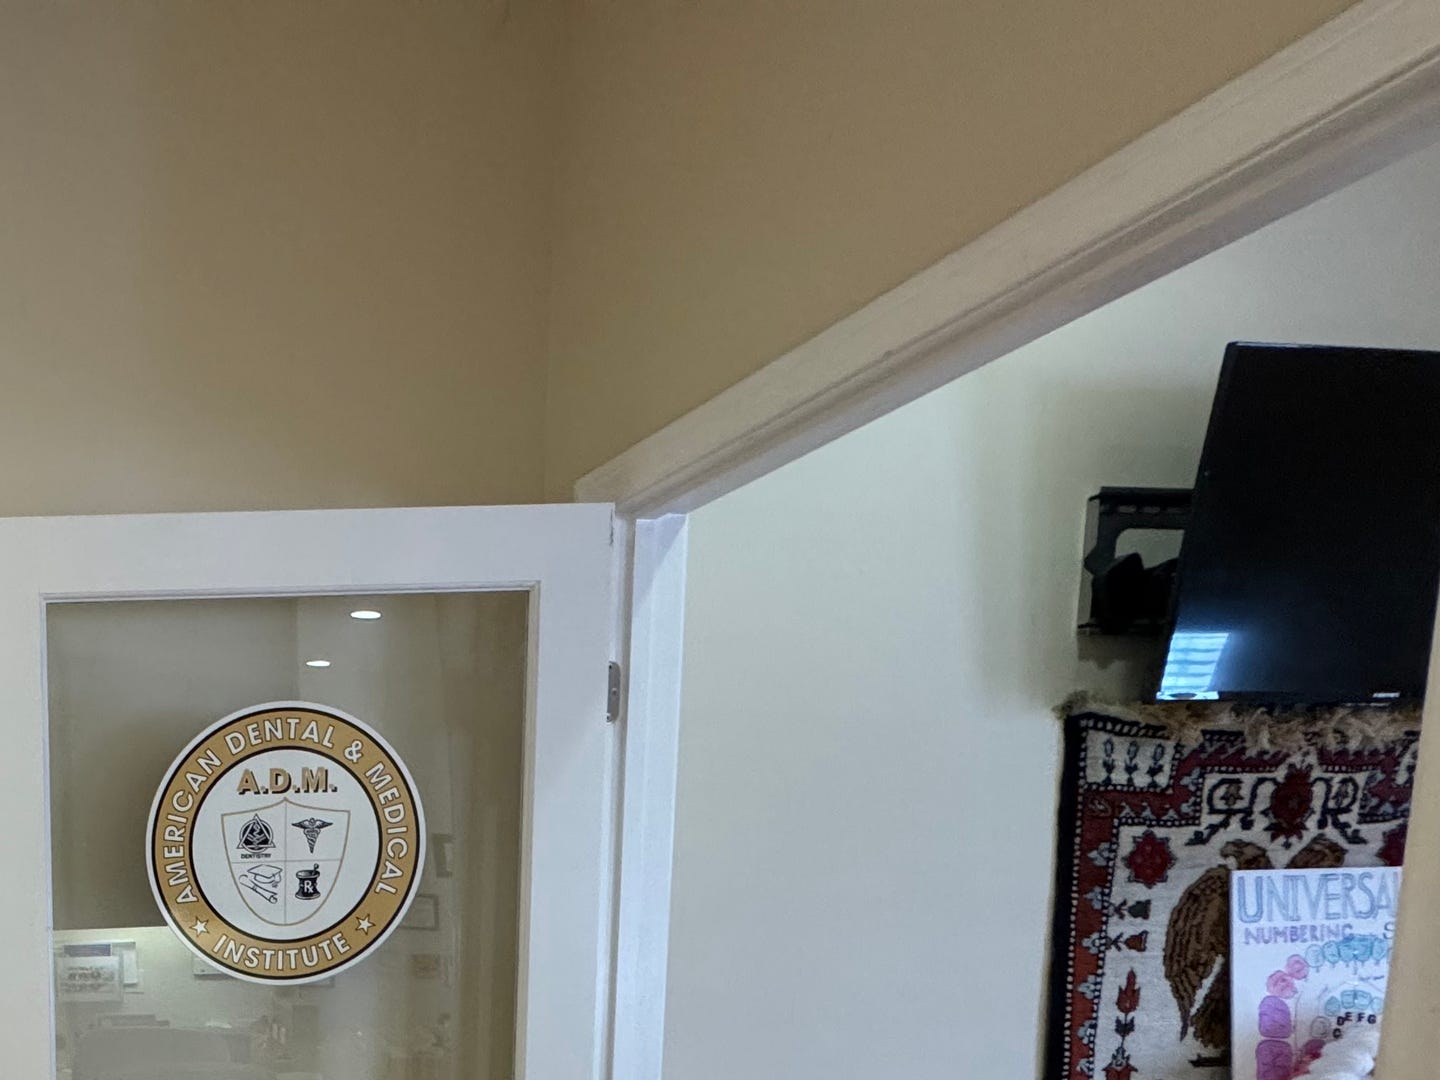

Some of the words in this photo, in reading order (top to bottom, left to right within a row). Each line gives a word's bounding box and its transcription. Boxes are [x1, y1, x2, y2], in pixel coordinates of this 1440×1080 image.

[237, 766, 338, 795] A.D.M.
[163, 748, 222, 905] AMERICAN
[224, 717, 335, 755] DENTAL
[344, 740, 364, 763] &
[364, 762, 409, 894] MEDICAL
[1244, 923, 1354, 945] NUMBERING
[213, 932, 350, 971] INSTITUTE
